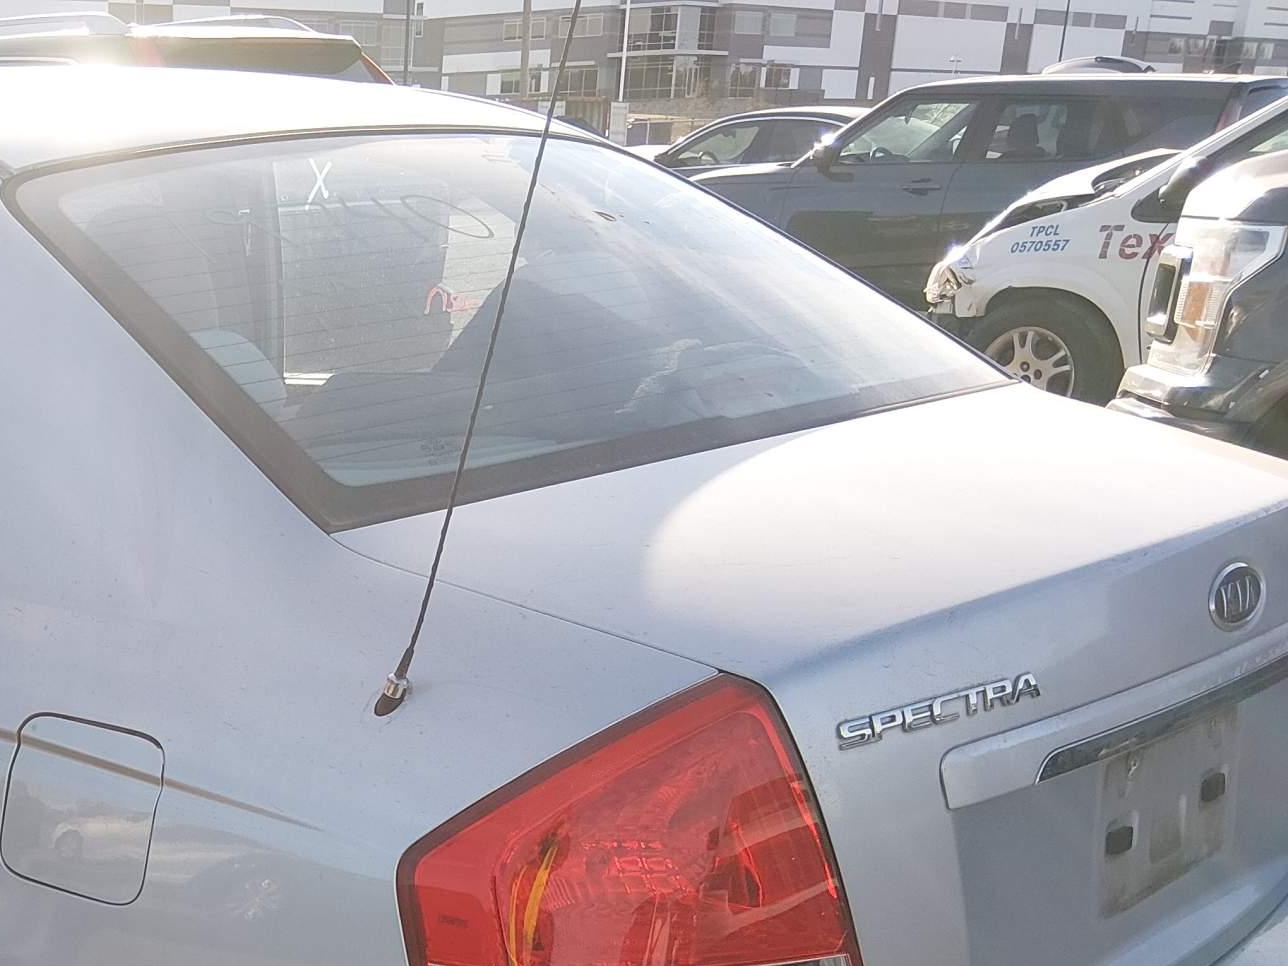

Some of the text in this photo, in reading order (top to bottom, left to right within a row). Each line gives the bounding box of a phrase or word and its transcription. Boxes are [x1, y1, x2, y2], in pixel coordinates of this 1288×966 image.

[1030, 224, 1060, 237] TPCL
[1010, 239, 1070, 254] 0570557
[836, 671, 1041, 750] SPECTRA
